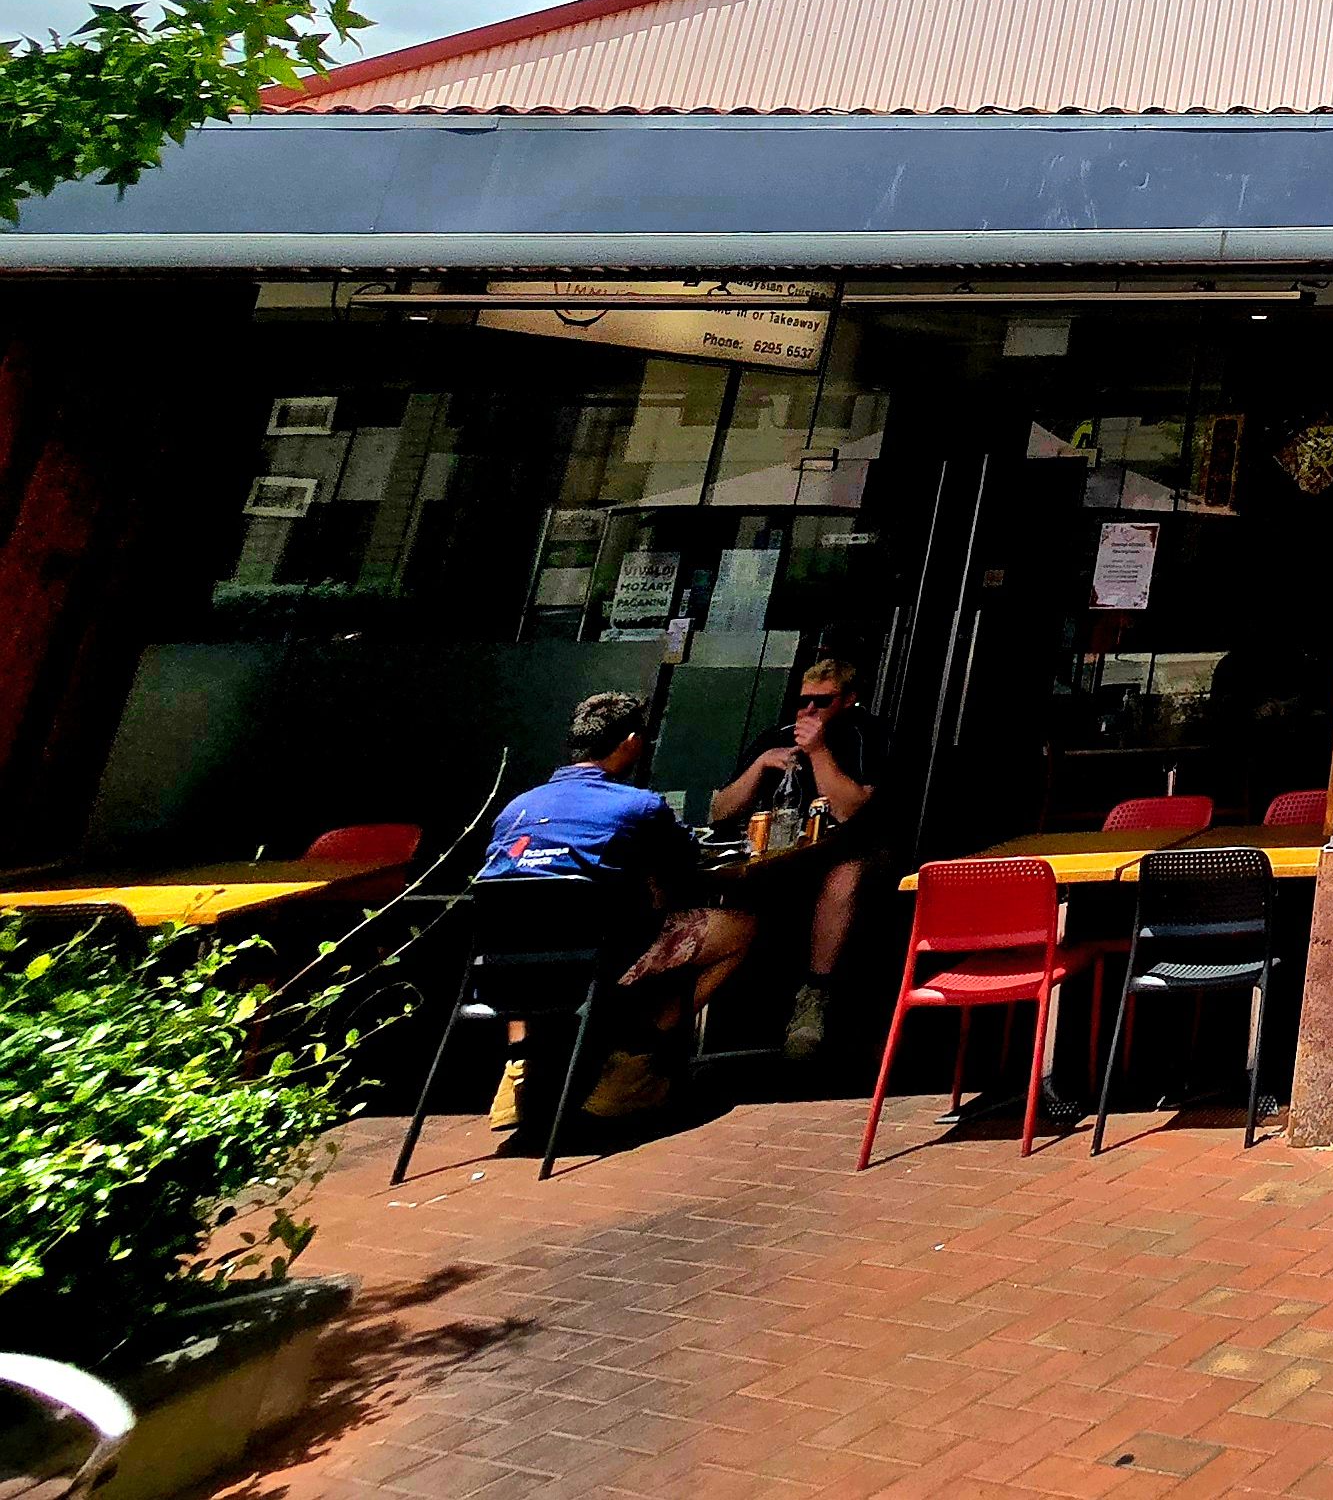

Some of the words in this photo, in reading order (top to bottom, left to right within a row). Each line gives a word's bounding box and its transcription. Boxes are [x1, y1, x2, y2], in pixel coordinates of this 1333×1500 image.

[752, 311, 764, 320] or
[769, 312, 820, 332] Takeaway
[703, 332, 743, 350] Phone:
[753, 340, 782, 355] 6295
[786, 345, 815, 359] 6537
[620, 582, 672, 592] MOZART
